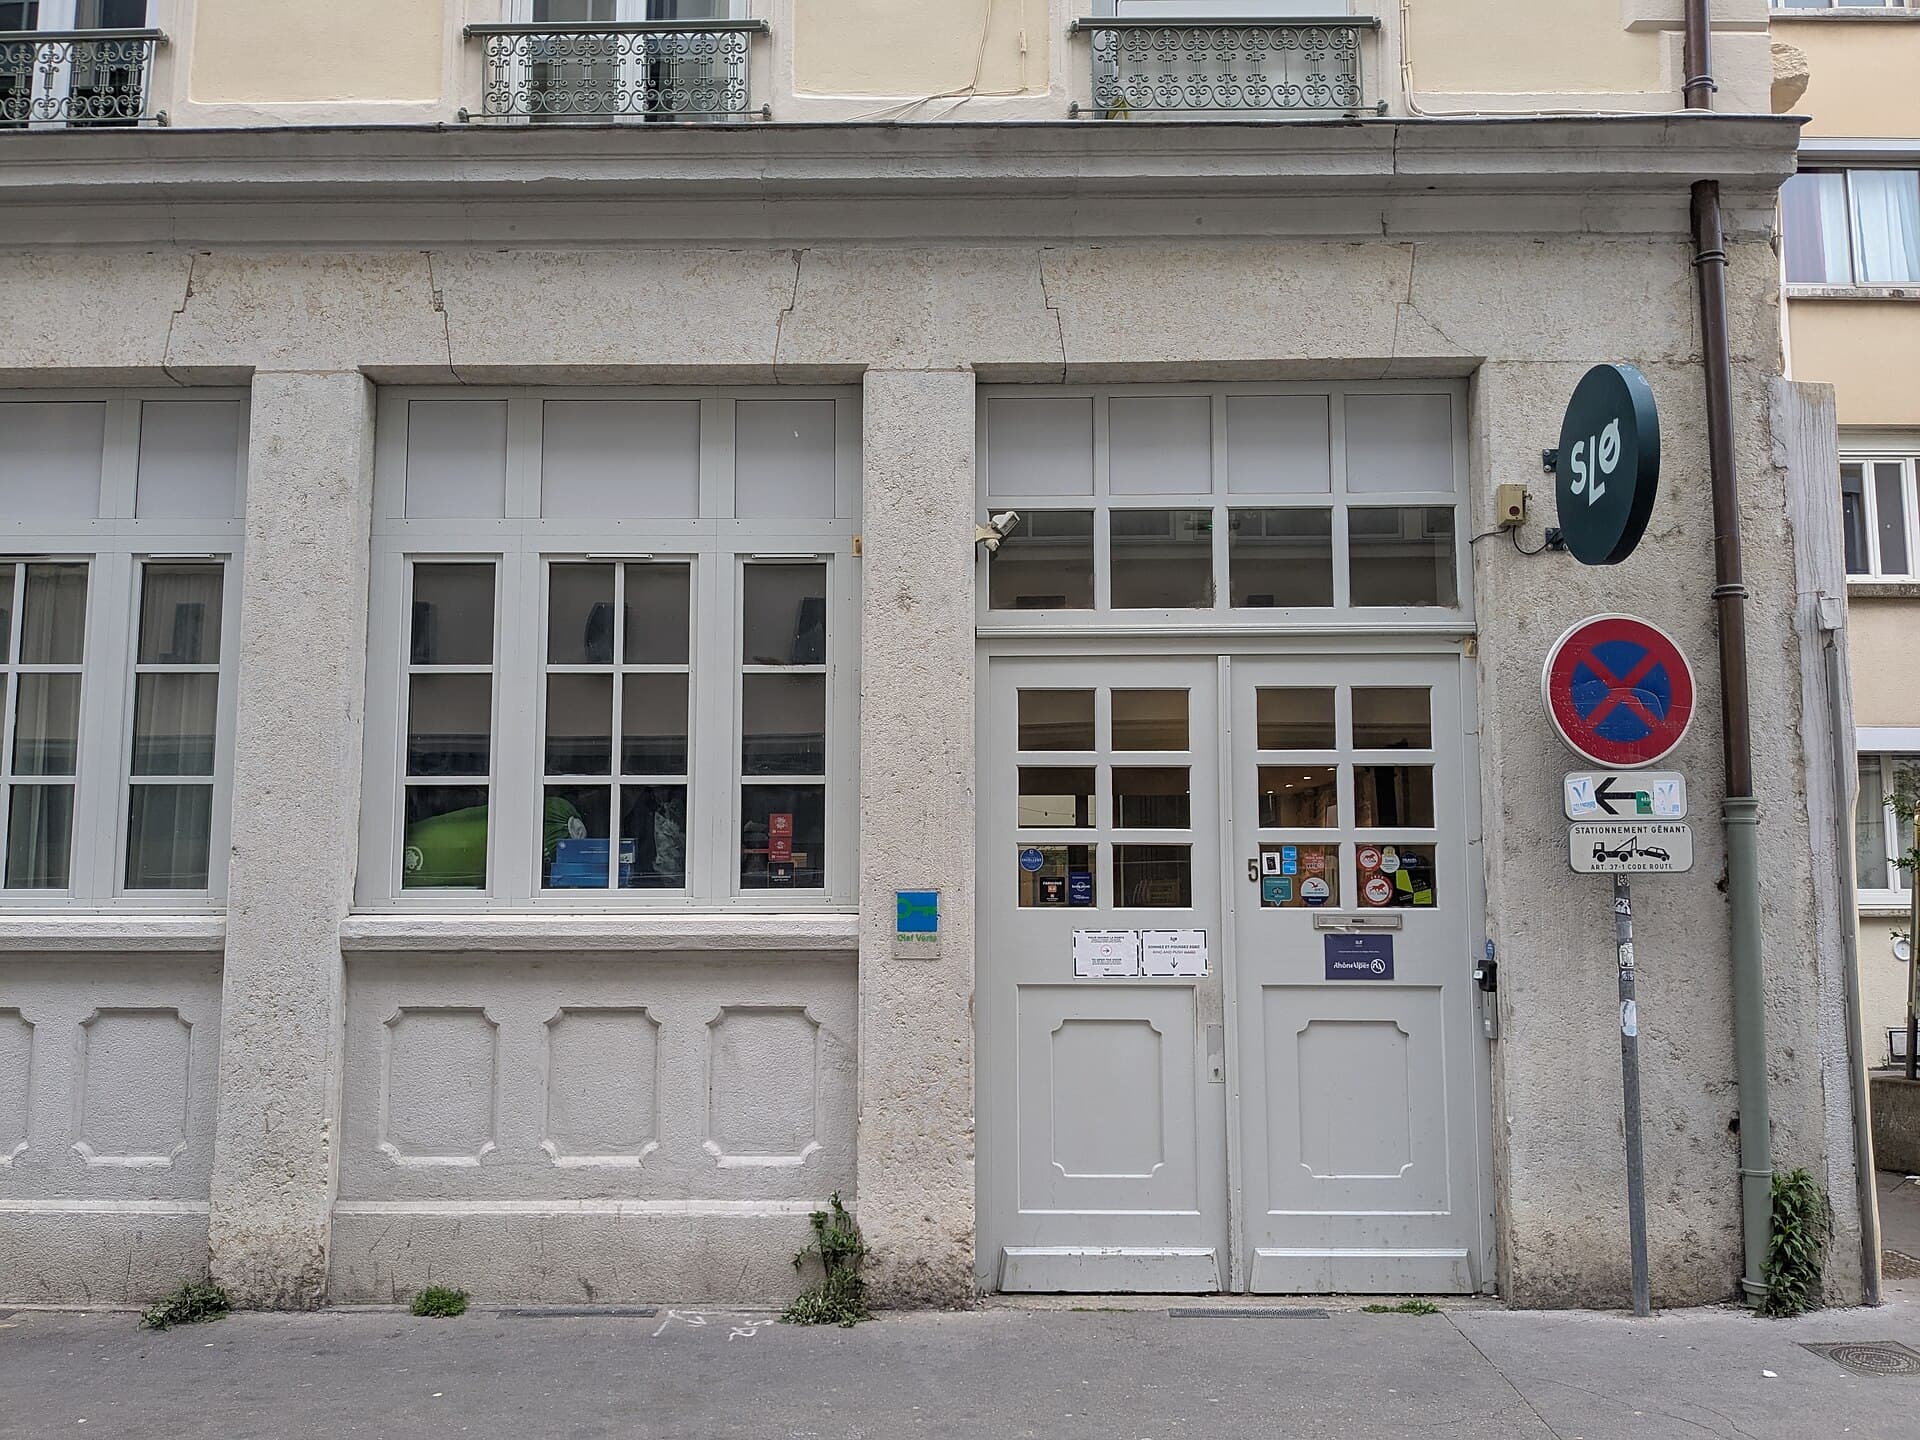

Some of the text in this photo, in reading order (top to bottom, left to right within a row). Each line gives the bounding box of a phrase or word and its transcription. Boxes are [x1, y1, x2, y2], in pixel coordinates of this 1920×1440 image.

[1575, 825, 1686, 834] STATIONNEMENT GÊNANT
[1247, 858, 1259, 882] 5
